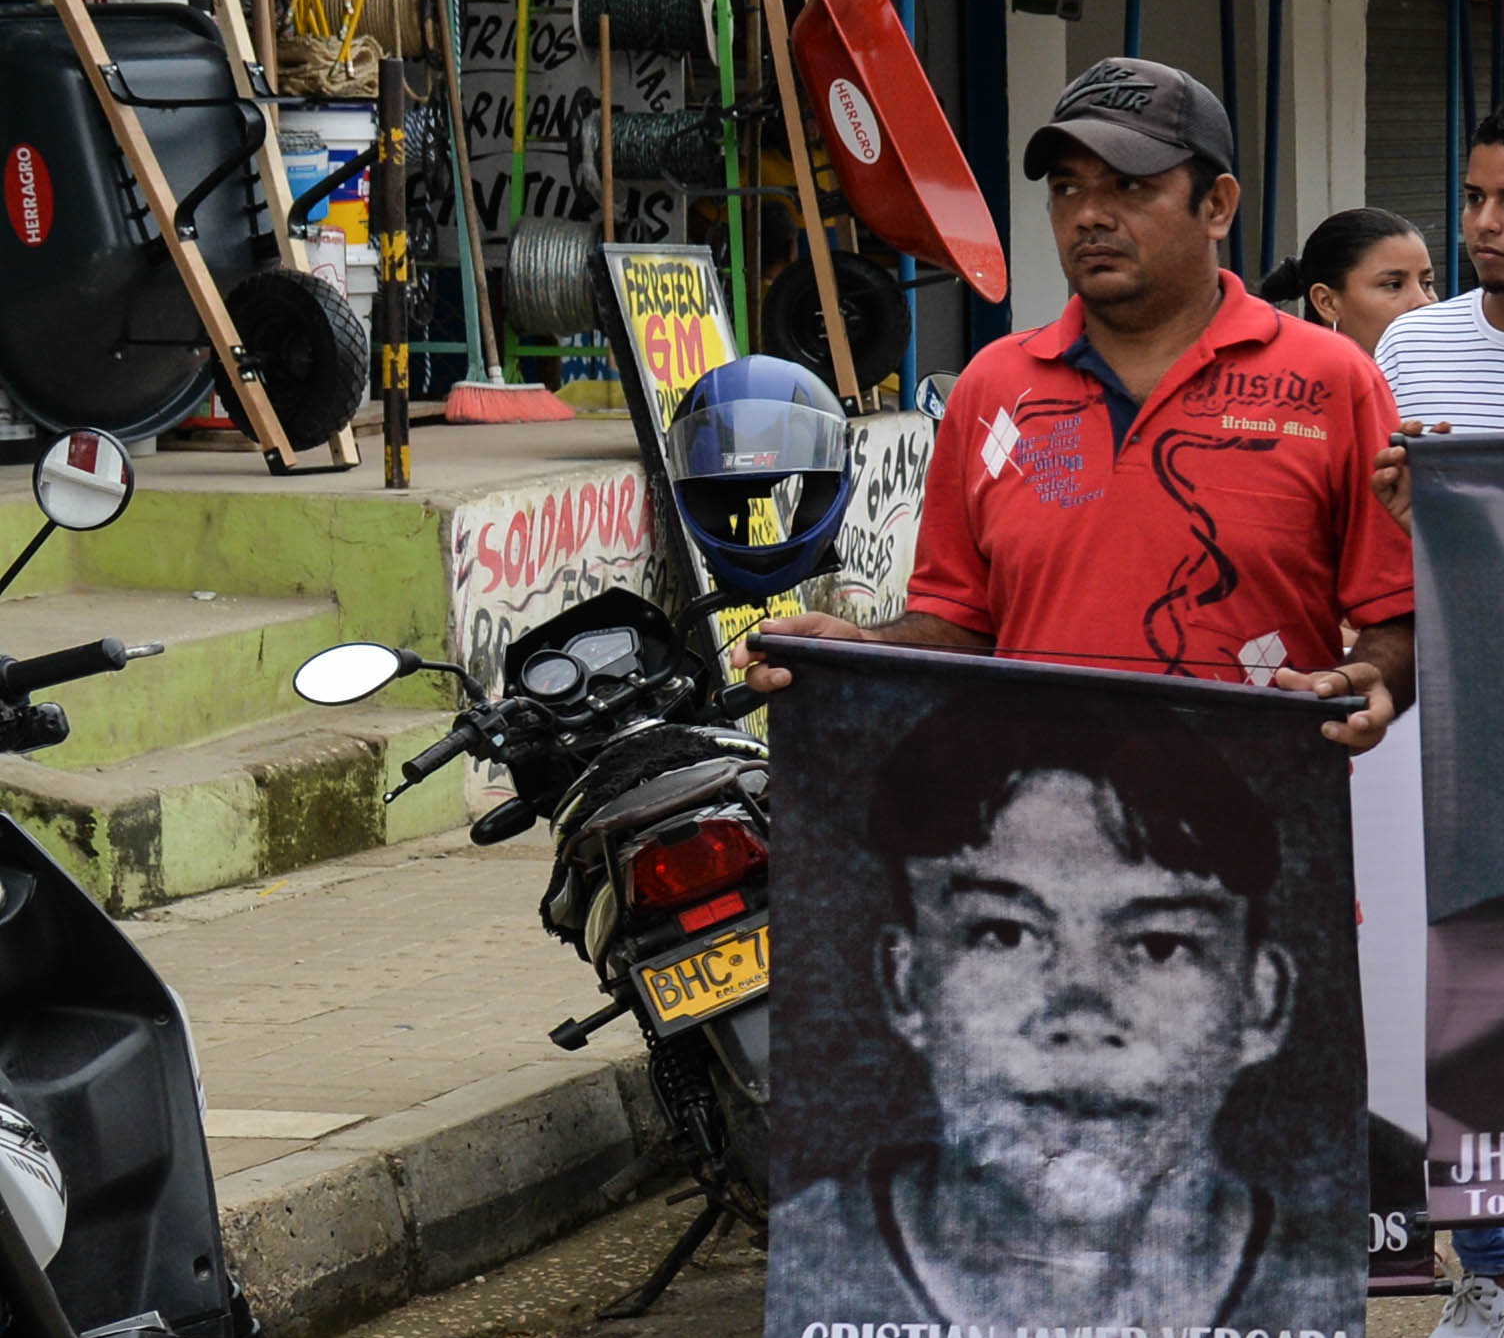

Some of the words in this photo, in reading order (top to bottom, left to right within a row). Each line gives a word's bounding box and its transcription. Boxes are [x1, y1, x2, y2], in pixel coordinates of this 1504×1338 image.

[834, 82, 875, 160] HERRAGRO
[1093, 86, 1152, 114] AIR
[15, 146, 42, 243] HERRAGRO
[623, 257, 719, 320] FERRETERIA
[644, 314, 707, 388] GM
[1283, 420, 1327, 440] Minds
[477, 473, 656, 594] SOLDADURA
[650, 950, 733, 1011] BHC
